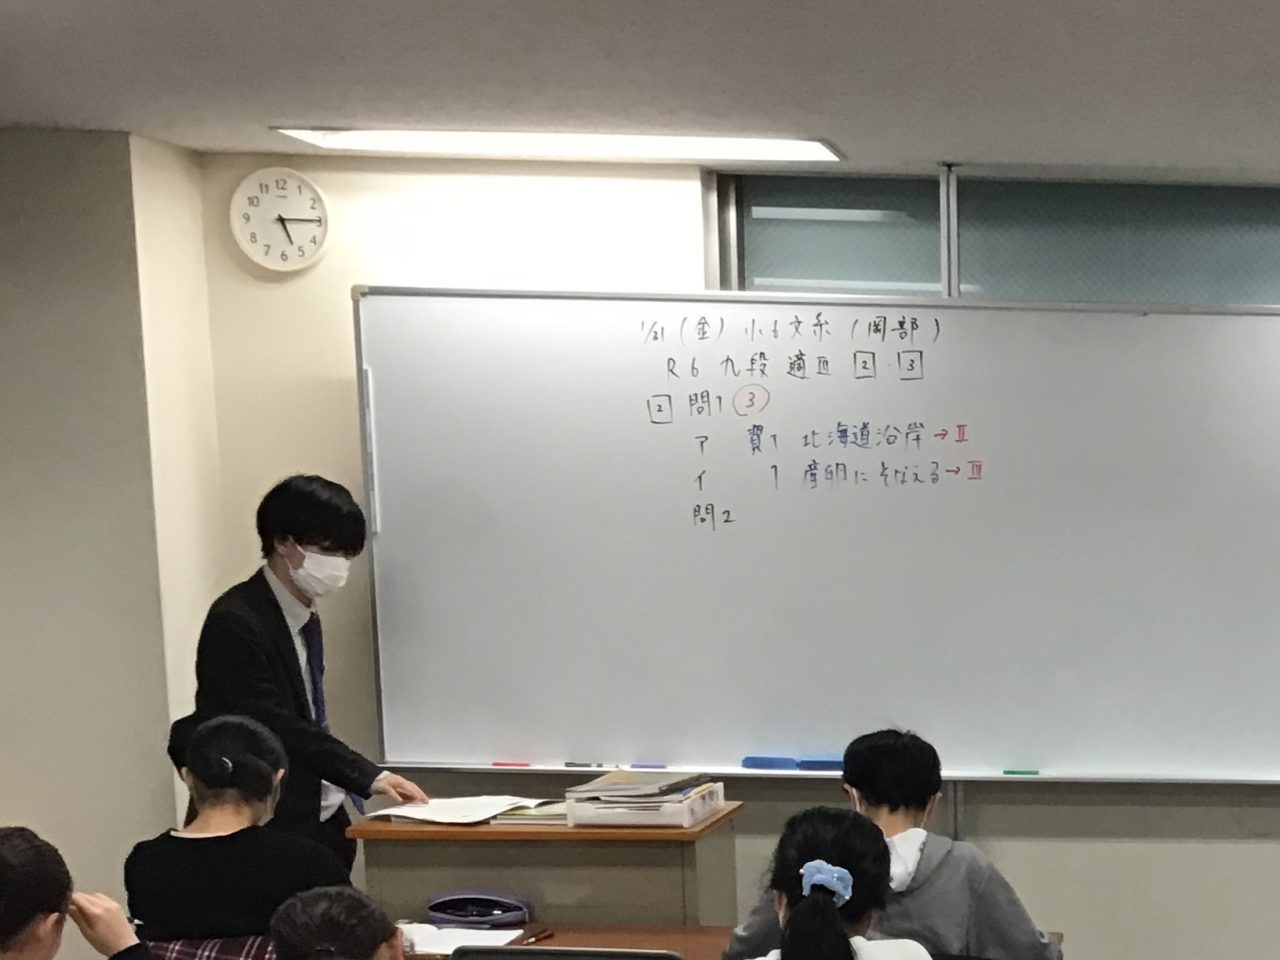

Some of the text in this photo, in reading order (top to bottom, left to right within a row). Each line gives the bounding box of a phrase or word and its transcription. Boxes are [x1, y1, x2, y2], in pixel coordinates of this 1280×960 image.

[259, 183, 269, 194] 11
[275, 179, 287, 190] 12
[247, 196, 259, 207] 10
[310, 198, 317, 210] 2
[243, 212, 250, 223] 9
[250, 232, 258, 243] 8
[310, 235, 317, 245] 4
[264, 244, 271, 256] 7
[298, 246, 305, 257] 5
[280, 251, 288, 261] 6
